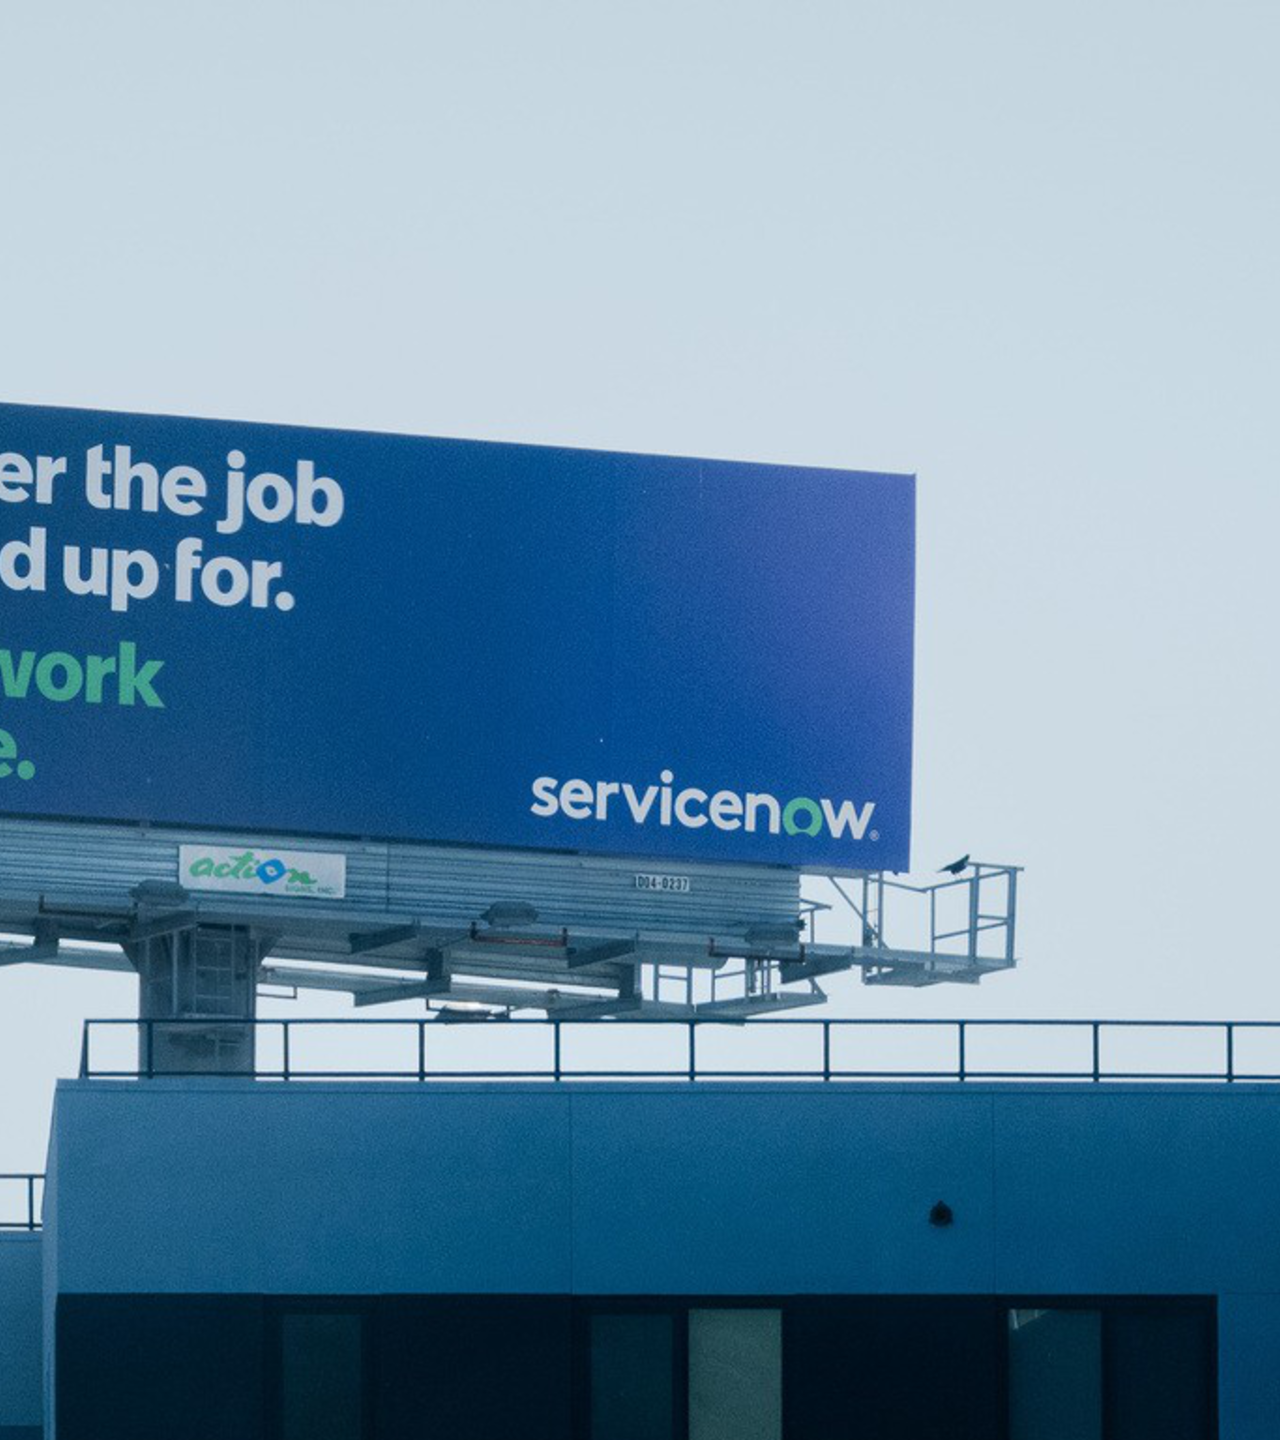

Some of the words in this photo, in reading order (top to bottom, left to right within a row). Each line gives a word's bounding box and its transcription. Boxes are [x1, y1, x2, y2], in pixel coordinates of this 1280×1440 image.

[85, 443, 207, 516] the
[216, 449, 345, 533] job
[63, 545, 160, 612] up
[175, 537, 296, 612] for.
[189, 851, 318, 885] action
